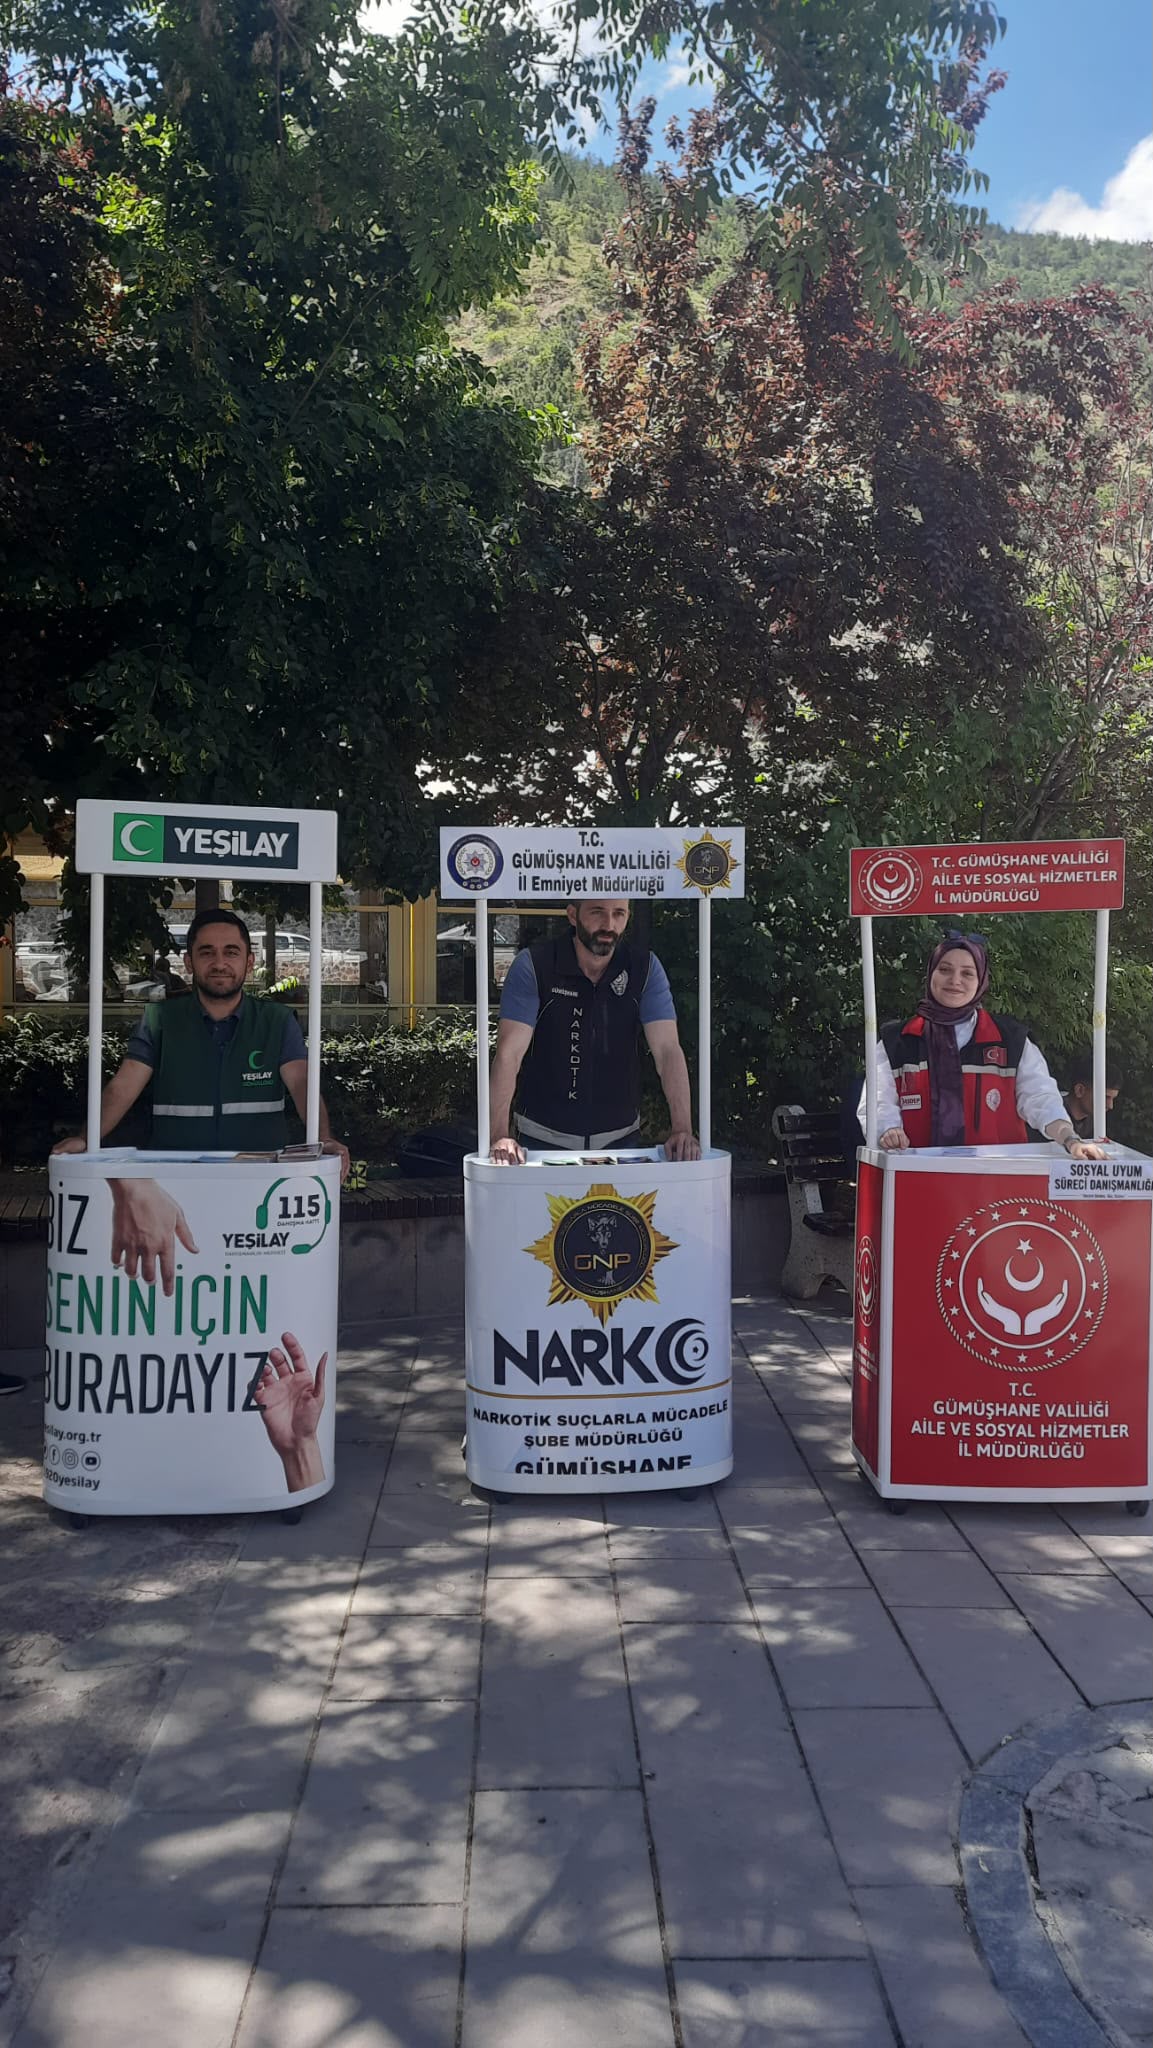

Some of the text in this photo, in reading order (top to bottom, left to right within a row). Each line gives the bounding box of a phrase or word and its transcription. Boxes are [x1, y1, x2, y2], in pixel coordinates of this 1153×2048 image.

[174, 827, 290, 858] YEŞİLAY
[578, 831, 604, 847] T.C.
[512, 849, 671, 873] GÜMÜŞHANE VALİLİĞİ
[931, 850, 1109, 869] T.C. GÜMÜŞHANE VALİLİĞİ
[518, 872, 665, 896] İl Emniyet Müdürlüğü
[931, 869, 1117, 886] AİLE VE SOSYAL HİZMETLER
[934, 890, 946, 904] İL
[1070, 1164, 1143, 1177] SOSYAL UYUM
[1054, 1177, 1087, 1190] SÜRECİ
[278, 1194, 320, 1219] 115
[222, 1232, 290, 1250] YEŞİLAY
[574, 1253, 631, 1271] GNP
[174, 1263, 268, 1346] İÇİN
[1008, 1383, 1036, 1396] T.C.
[473, 1399, 728, 1429] NARKOTİK SUÇLARLA MÜCADELE
[933, 1398, 1109, 1420] GÜMÜŞHANE VALİLİĞİ
[911, 1418, 1129, 1438] AİLE VE SOSYAL HİZMETLER
[524, 1427, 683, 1450] ŞUBE MÜDÜRLÜĞÜ
[958, 1440, 1085, 1459] İL MÜDÜRLÜĞÜ
